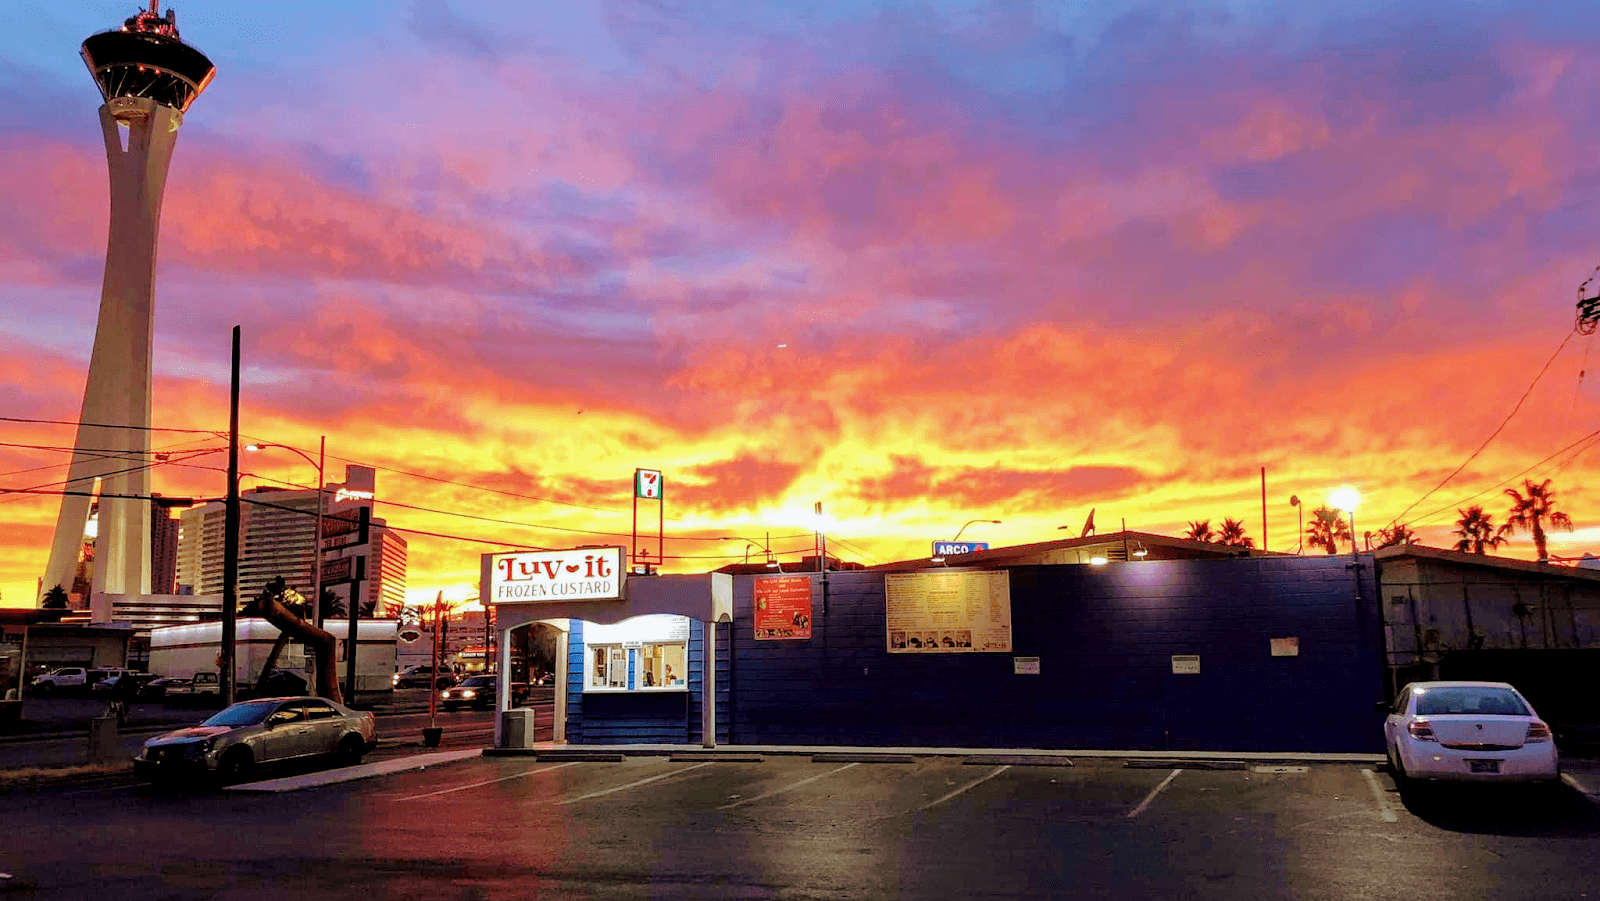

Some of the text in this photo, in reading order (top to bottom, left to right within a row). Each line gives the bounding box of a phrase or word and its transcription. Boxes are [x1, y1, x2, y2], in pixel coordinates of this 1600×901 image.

[939, 545, 969, 555] ARCO
[498, 581, 611, 598] FROZEN CUSTARD
